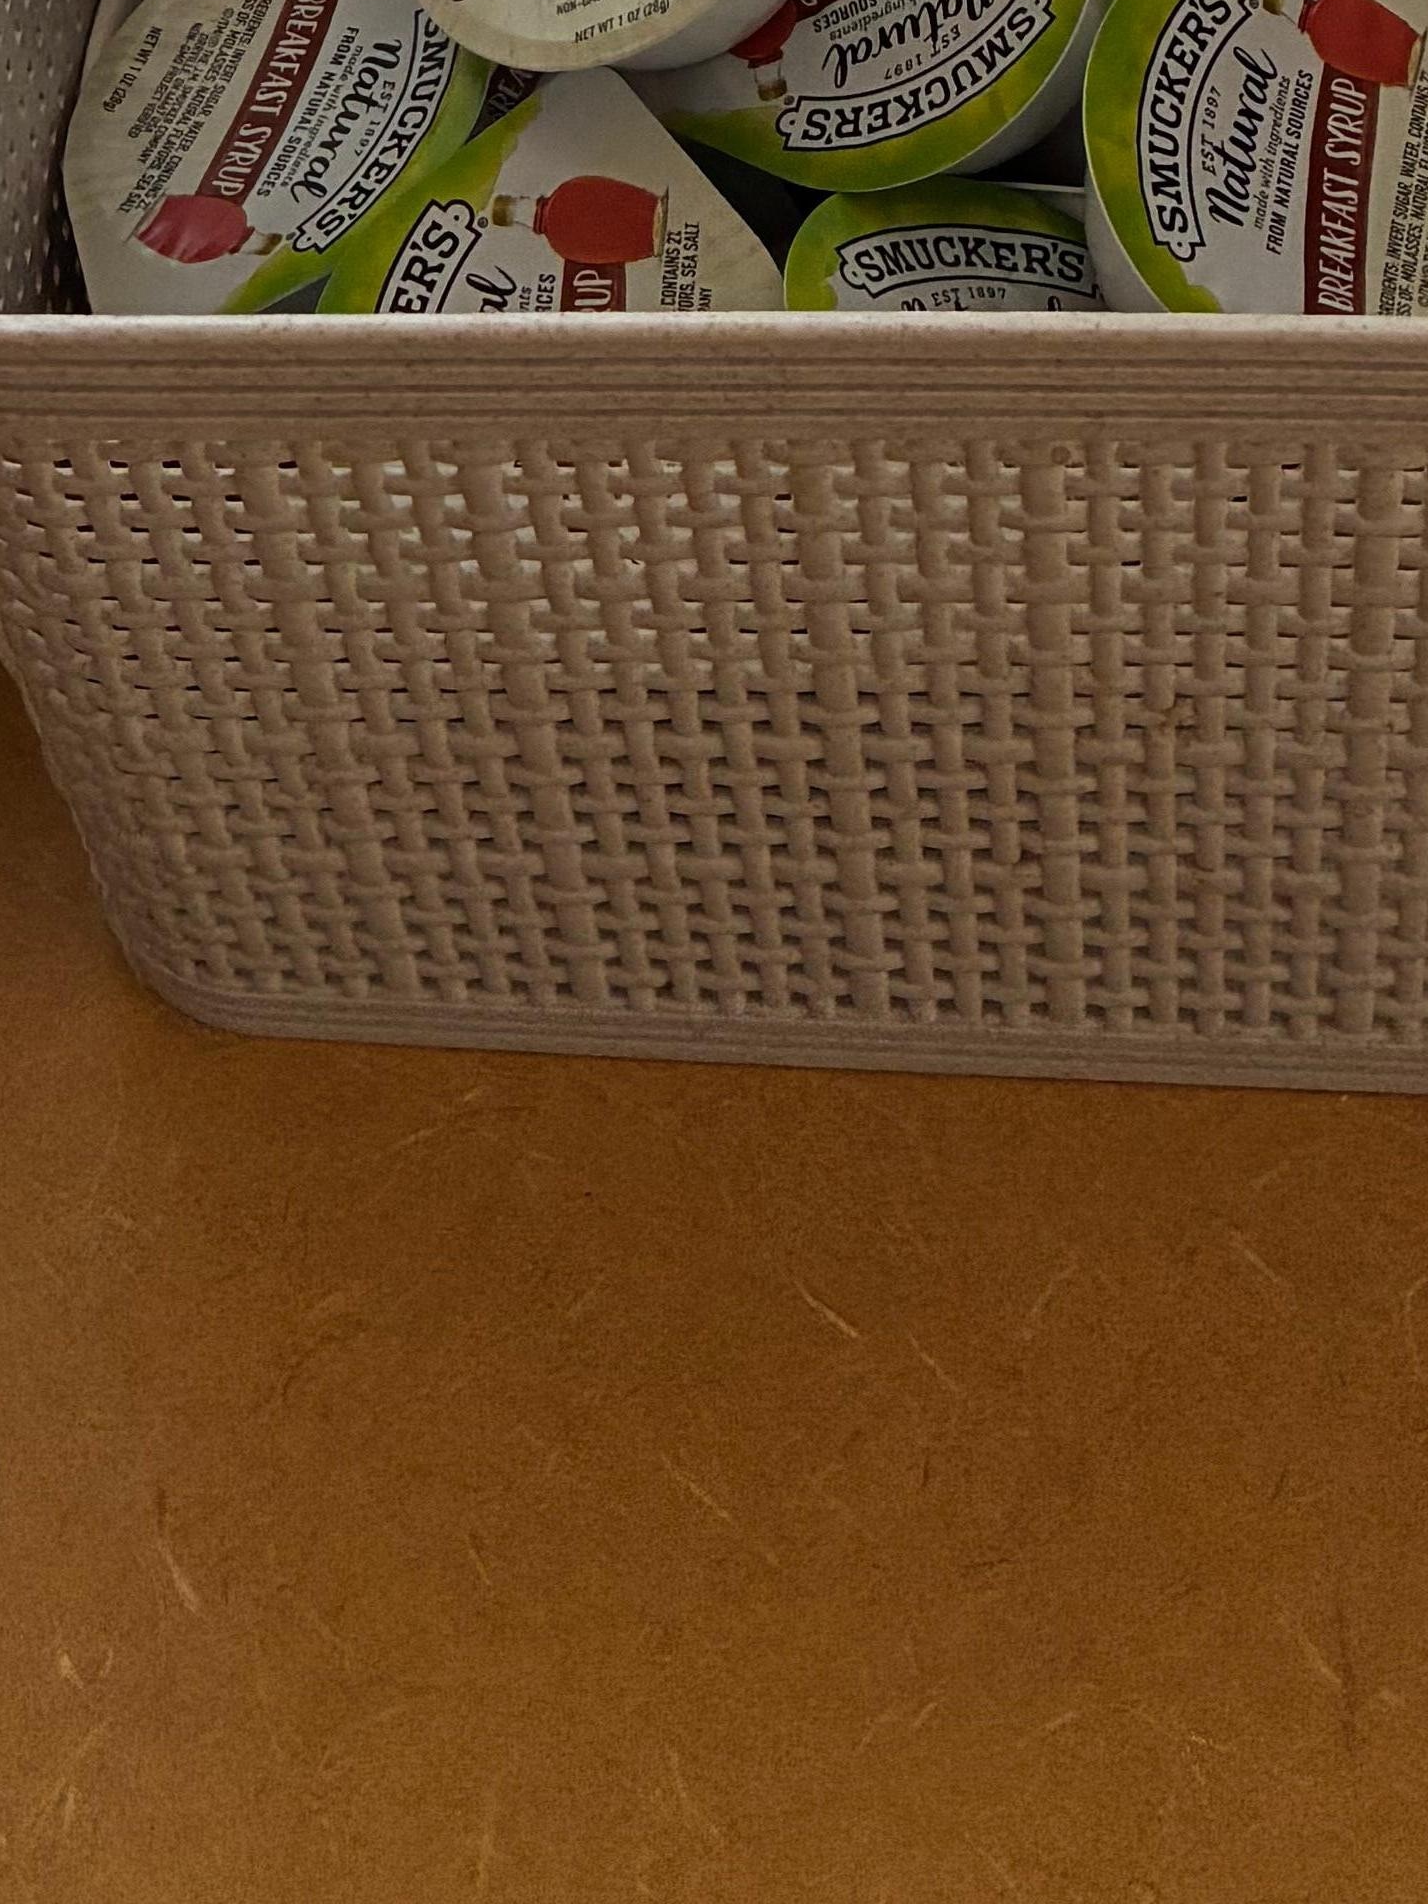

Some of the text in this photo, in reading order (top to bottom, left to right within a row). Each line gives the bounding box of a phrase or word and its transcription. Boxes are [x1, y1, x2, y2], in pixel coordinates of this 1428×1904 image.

[575, 24, 595, 43] NET
[801, 6, 1036, 145] SMUCKER'S
[211, 123, 272, 198] SYRUP
[291, 40, 402, 203] Natural
[1204, 46, 1280, 227] Natural
[855, 236, 1085, 282] SMUCKER'S
[1317, 77, 1367, 314] BREAKFAST SYRUP
